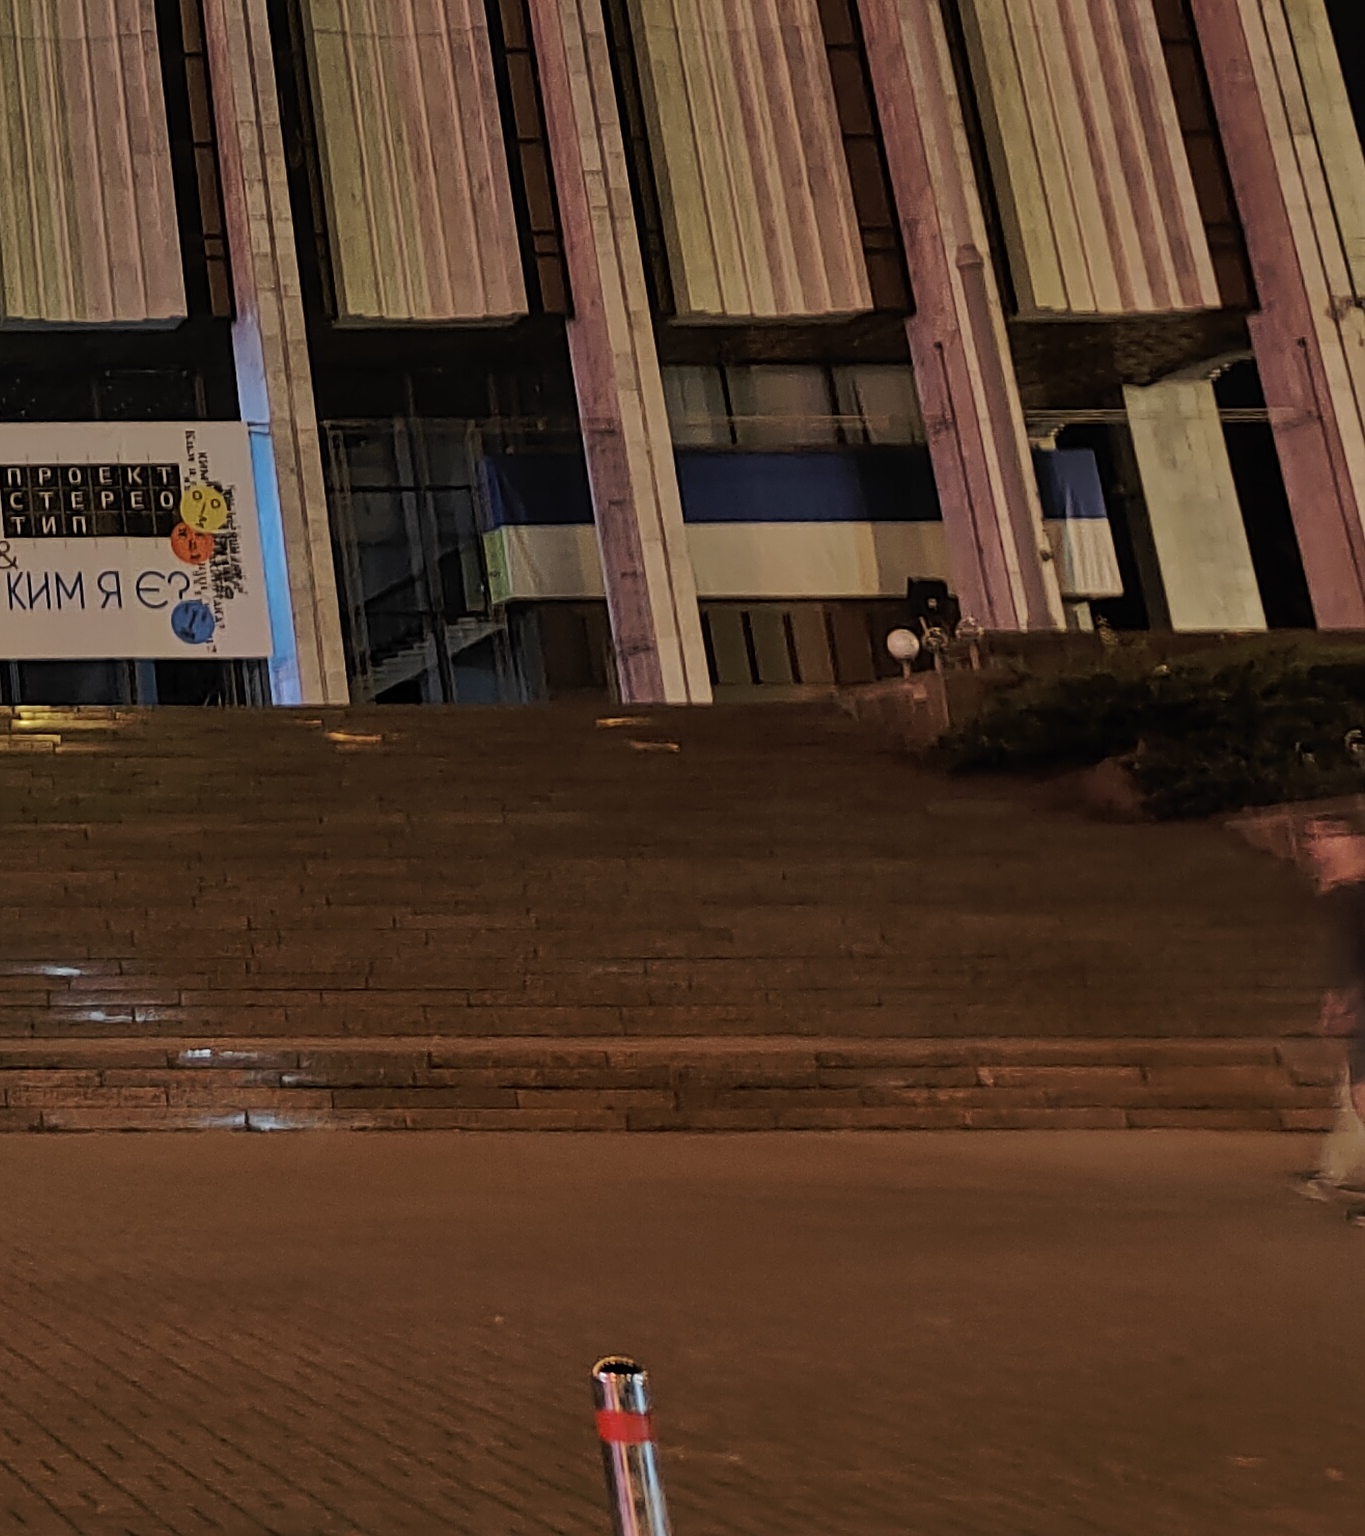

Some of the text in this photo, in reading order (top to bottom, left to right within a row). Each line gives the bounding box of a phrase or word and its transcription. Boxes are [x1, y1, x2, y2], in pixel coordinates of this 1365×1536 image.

[7, 466, 172, 487] ПРОЕКТ
[9, 490, 174, 511] СТЕРЕО
[10, 515, 87, 536] ТИП
[6, 571, 86, 611] КИМ
[97, 570, 123, 609] Я
[135, 570, 191, 610] Є?
